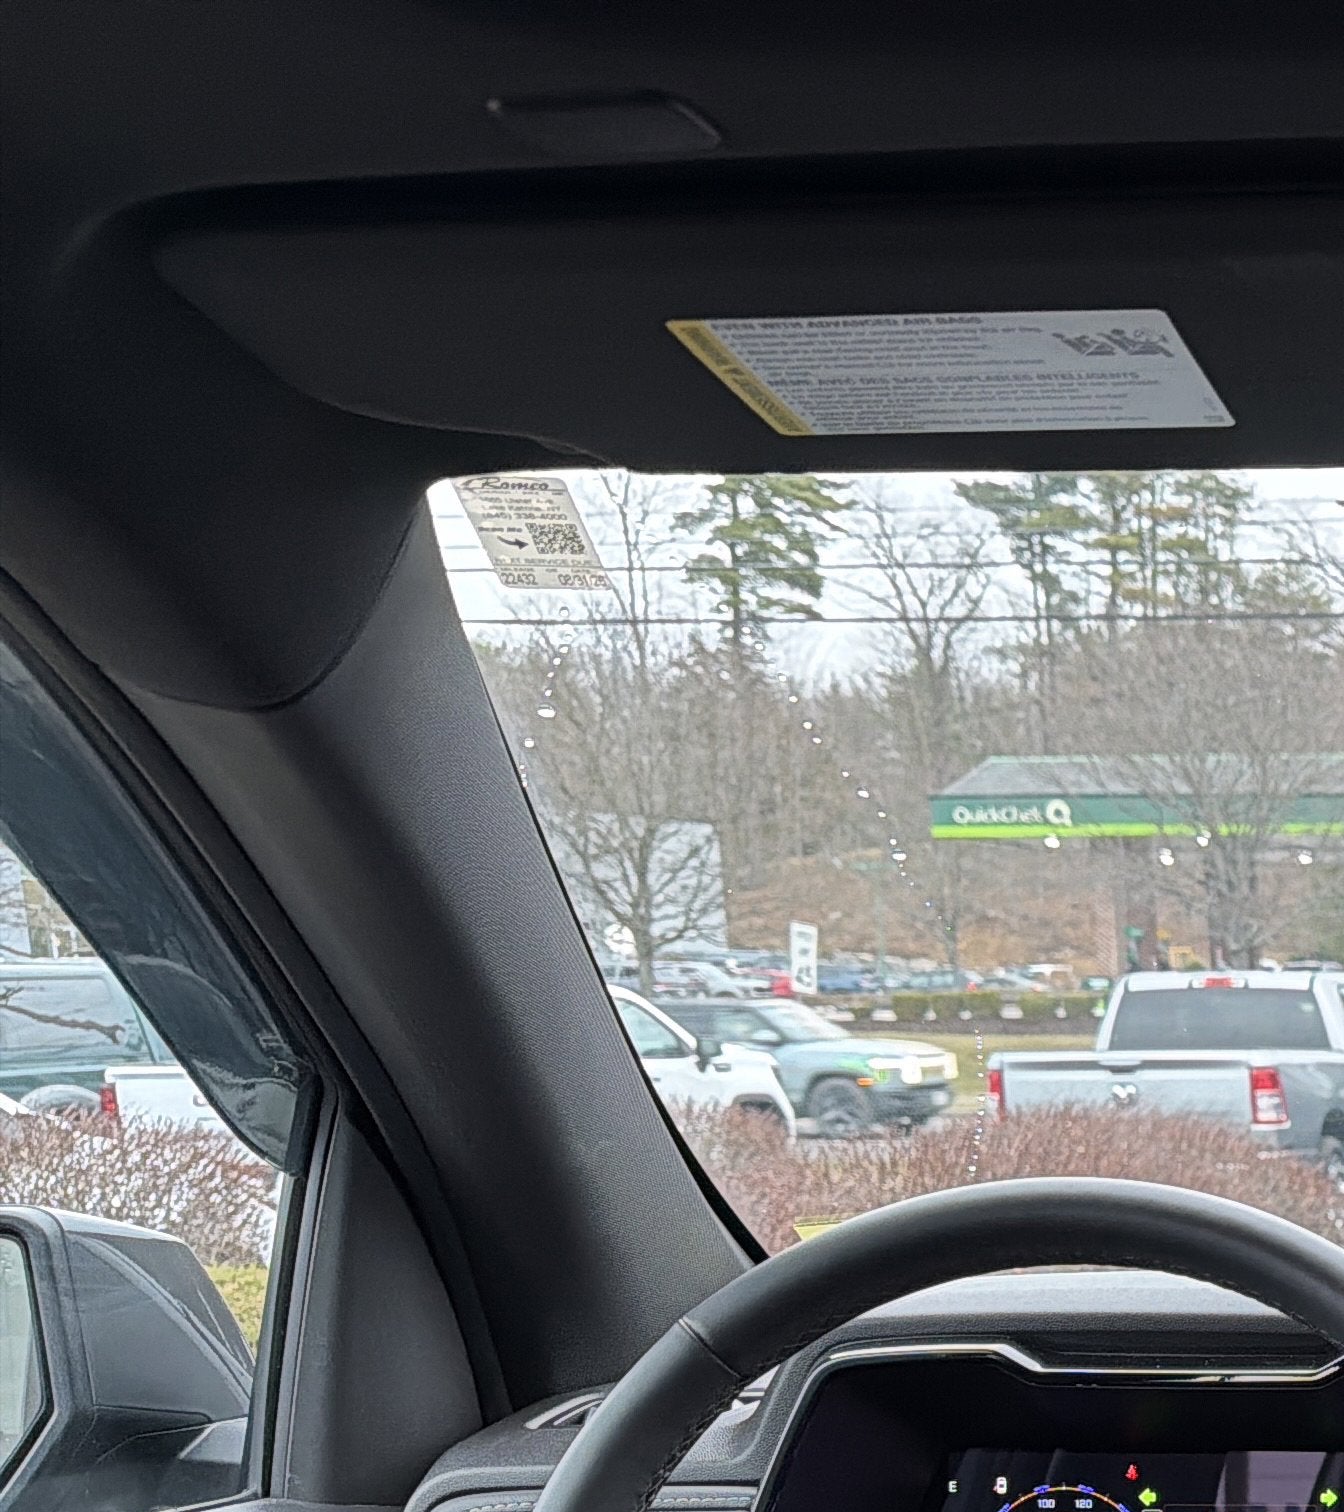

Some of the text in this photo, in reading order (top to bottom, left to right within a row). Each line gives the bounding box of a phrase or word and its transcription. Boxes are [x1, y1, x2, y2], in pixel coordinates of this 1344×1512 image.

[948, 1481, 958, 1493] E
[1037, 1499, 1056, 1509] 100
[1075, 1499, 1093, 1509] 120
